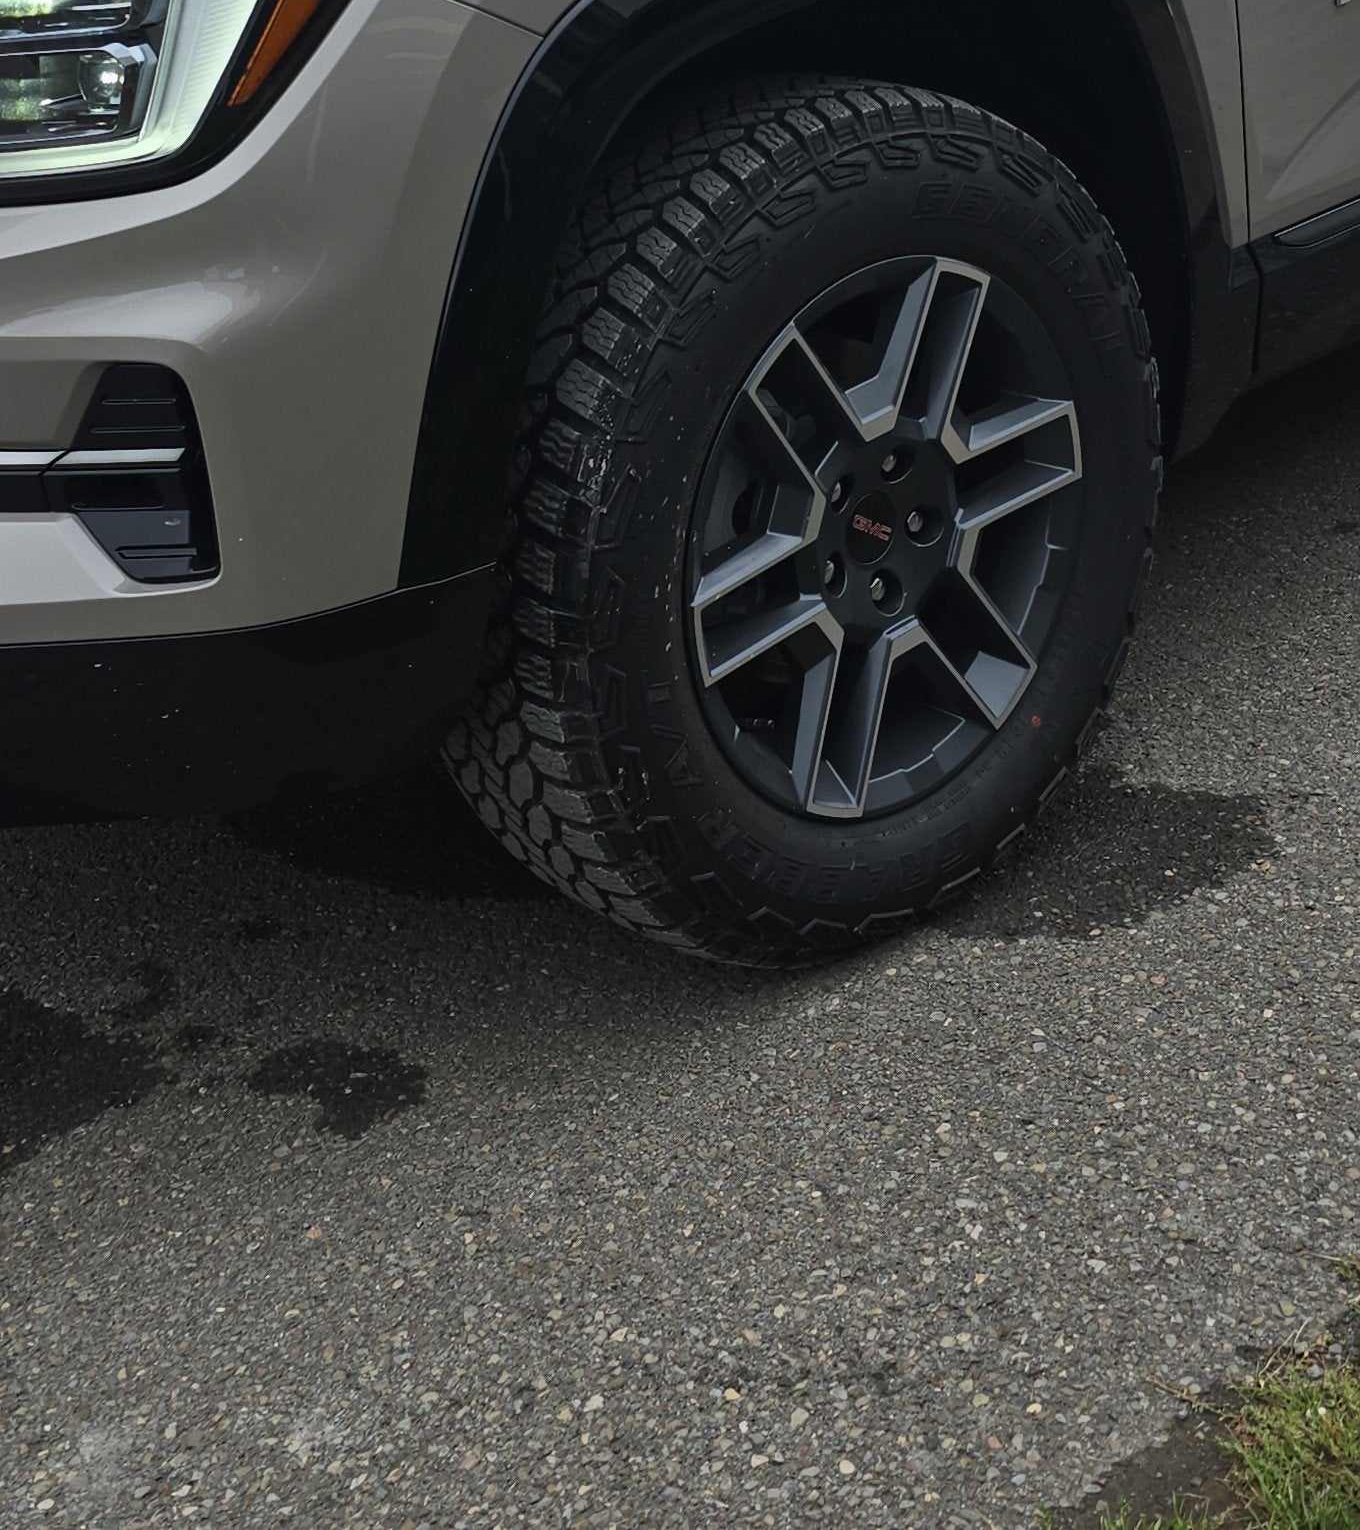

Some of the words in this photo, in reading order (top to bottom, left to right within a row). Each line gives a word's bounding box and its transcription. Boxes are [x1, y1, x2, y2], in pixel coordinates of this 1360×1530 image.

[907, 180, 1125, 378] GENERAL
[852, 514, 893, 541] GMC
[695, 810, 974, 905] GRABBER
